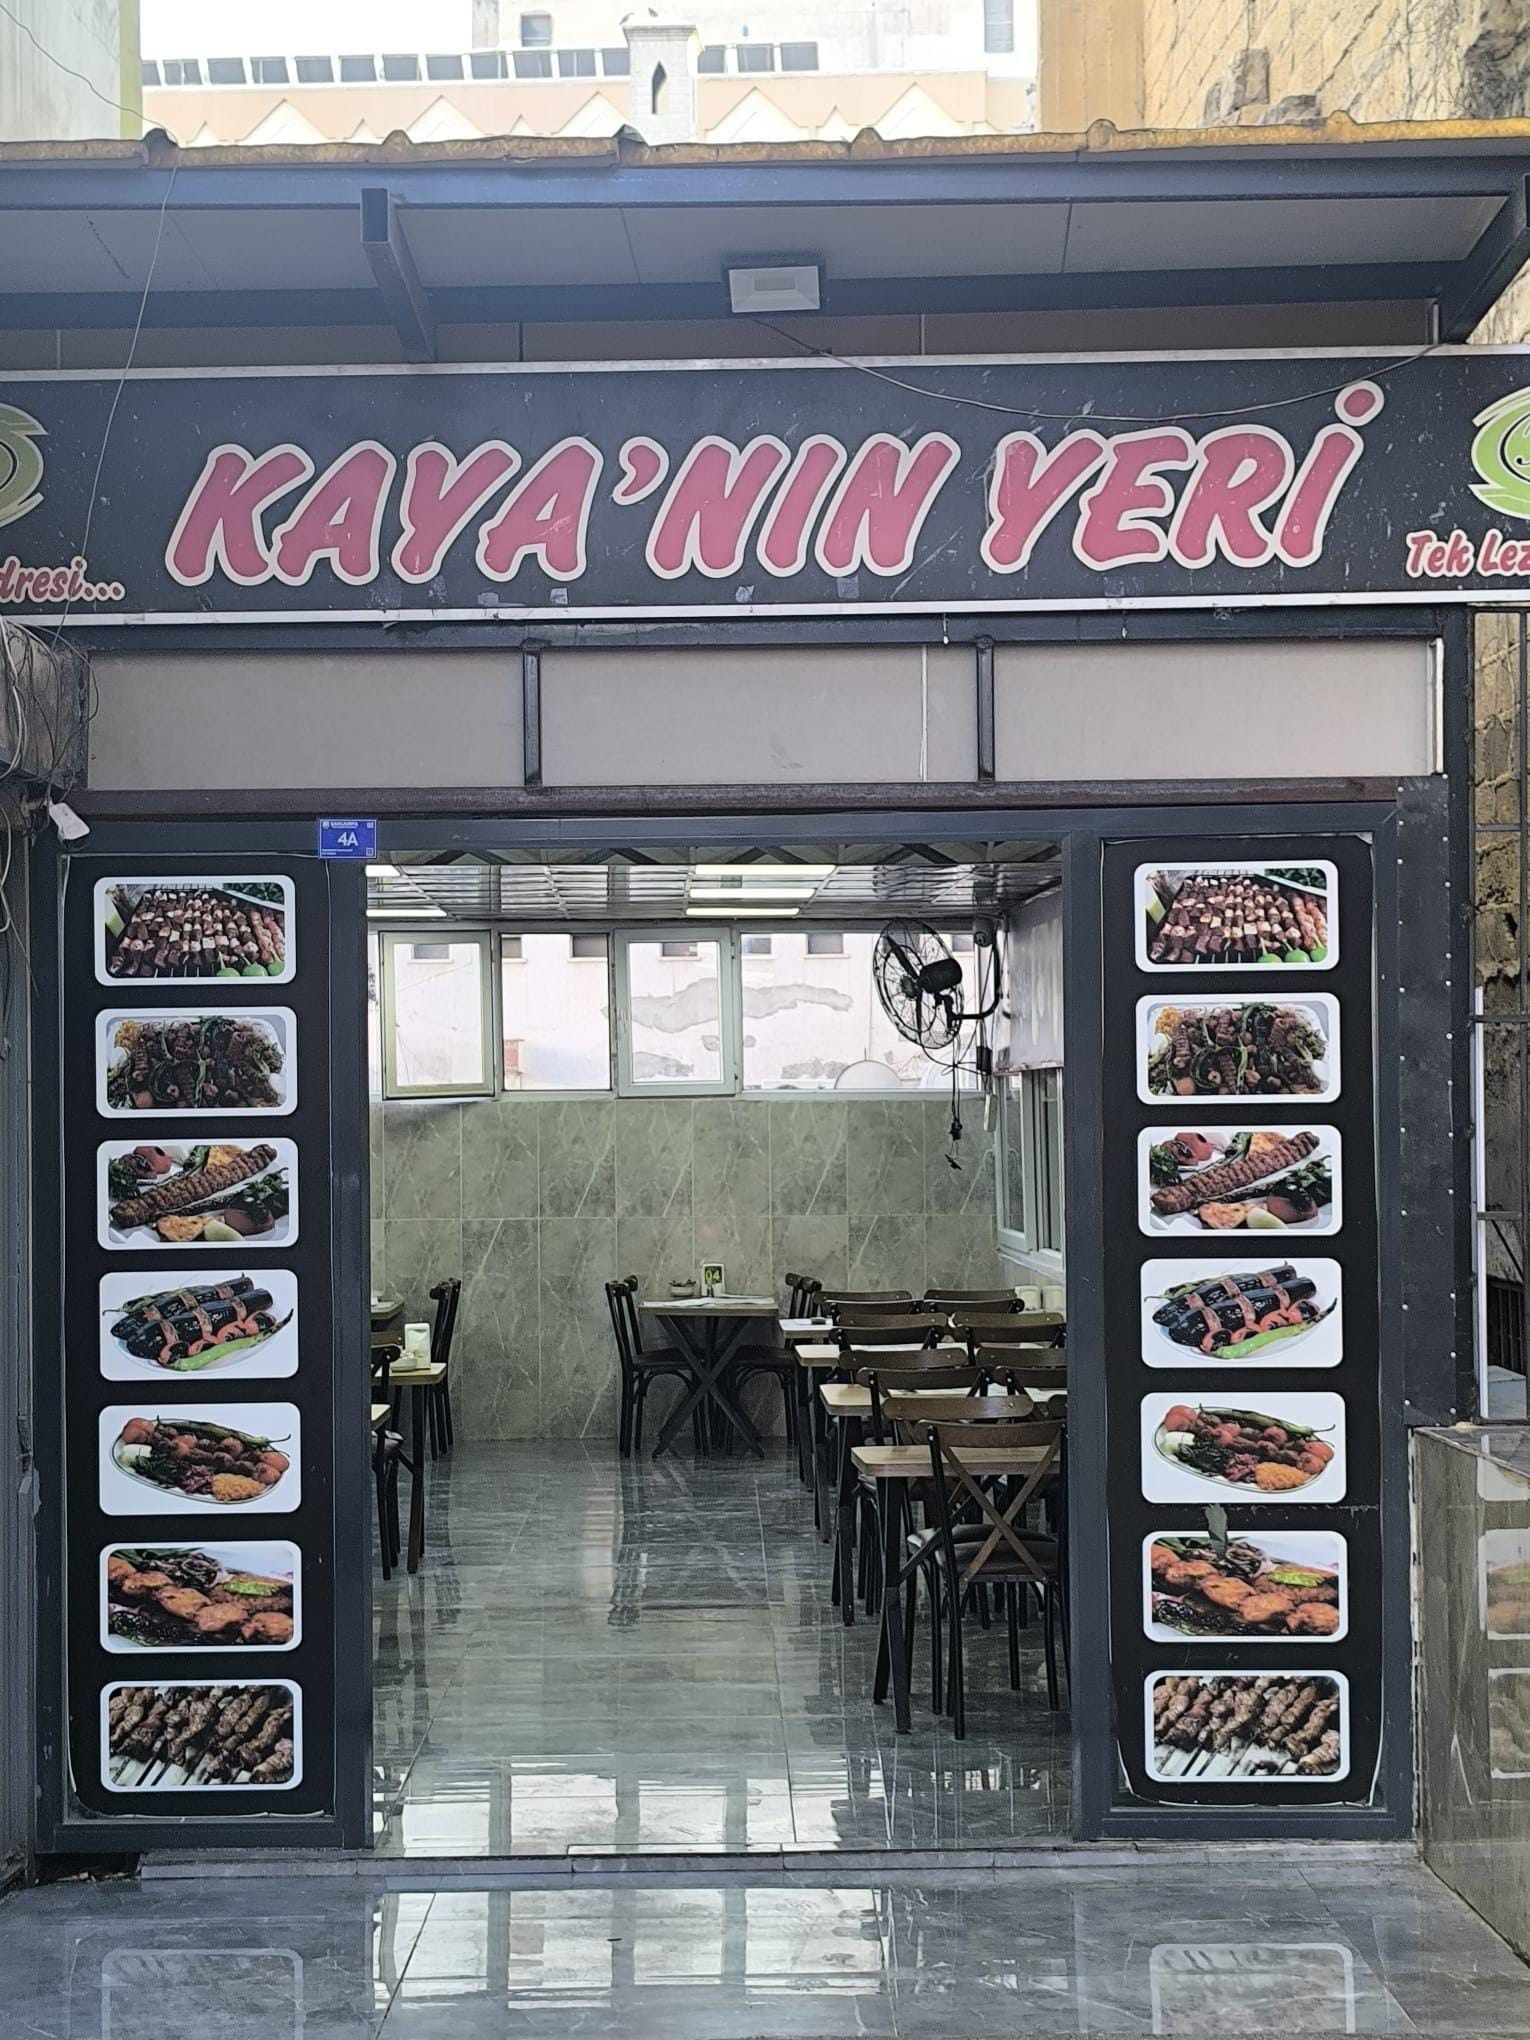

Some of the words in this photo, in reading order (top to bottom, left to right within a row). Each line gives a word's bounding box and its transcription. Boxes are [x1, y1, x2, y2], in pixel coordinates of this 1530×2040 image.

[1406, 529, 1474, 577] Tek
[337, 831, 358, 847] 4A
[706, 1270, 720, 1281] 04
